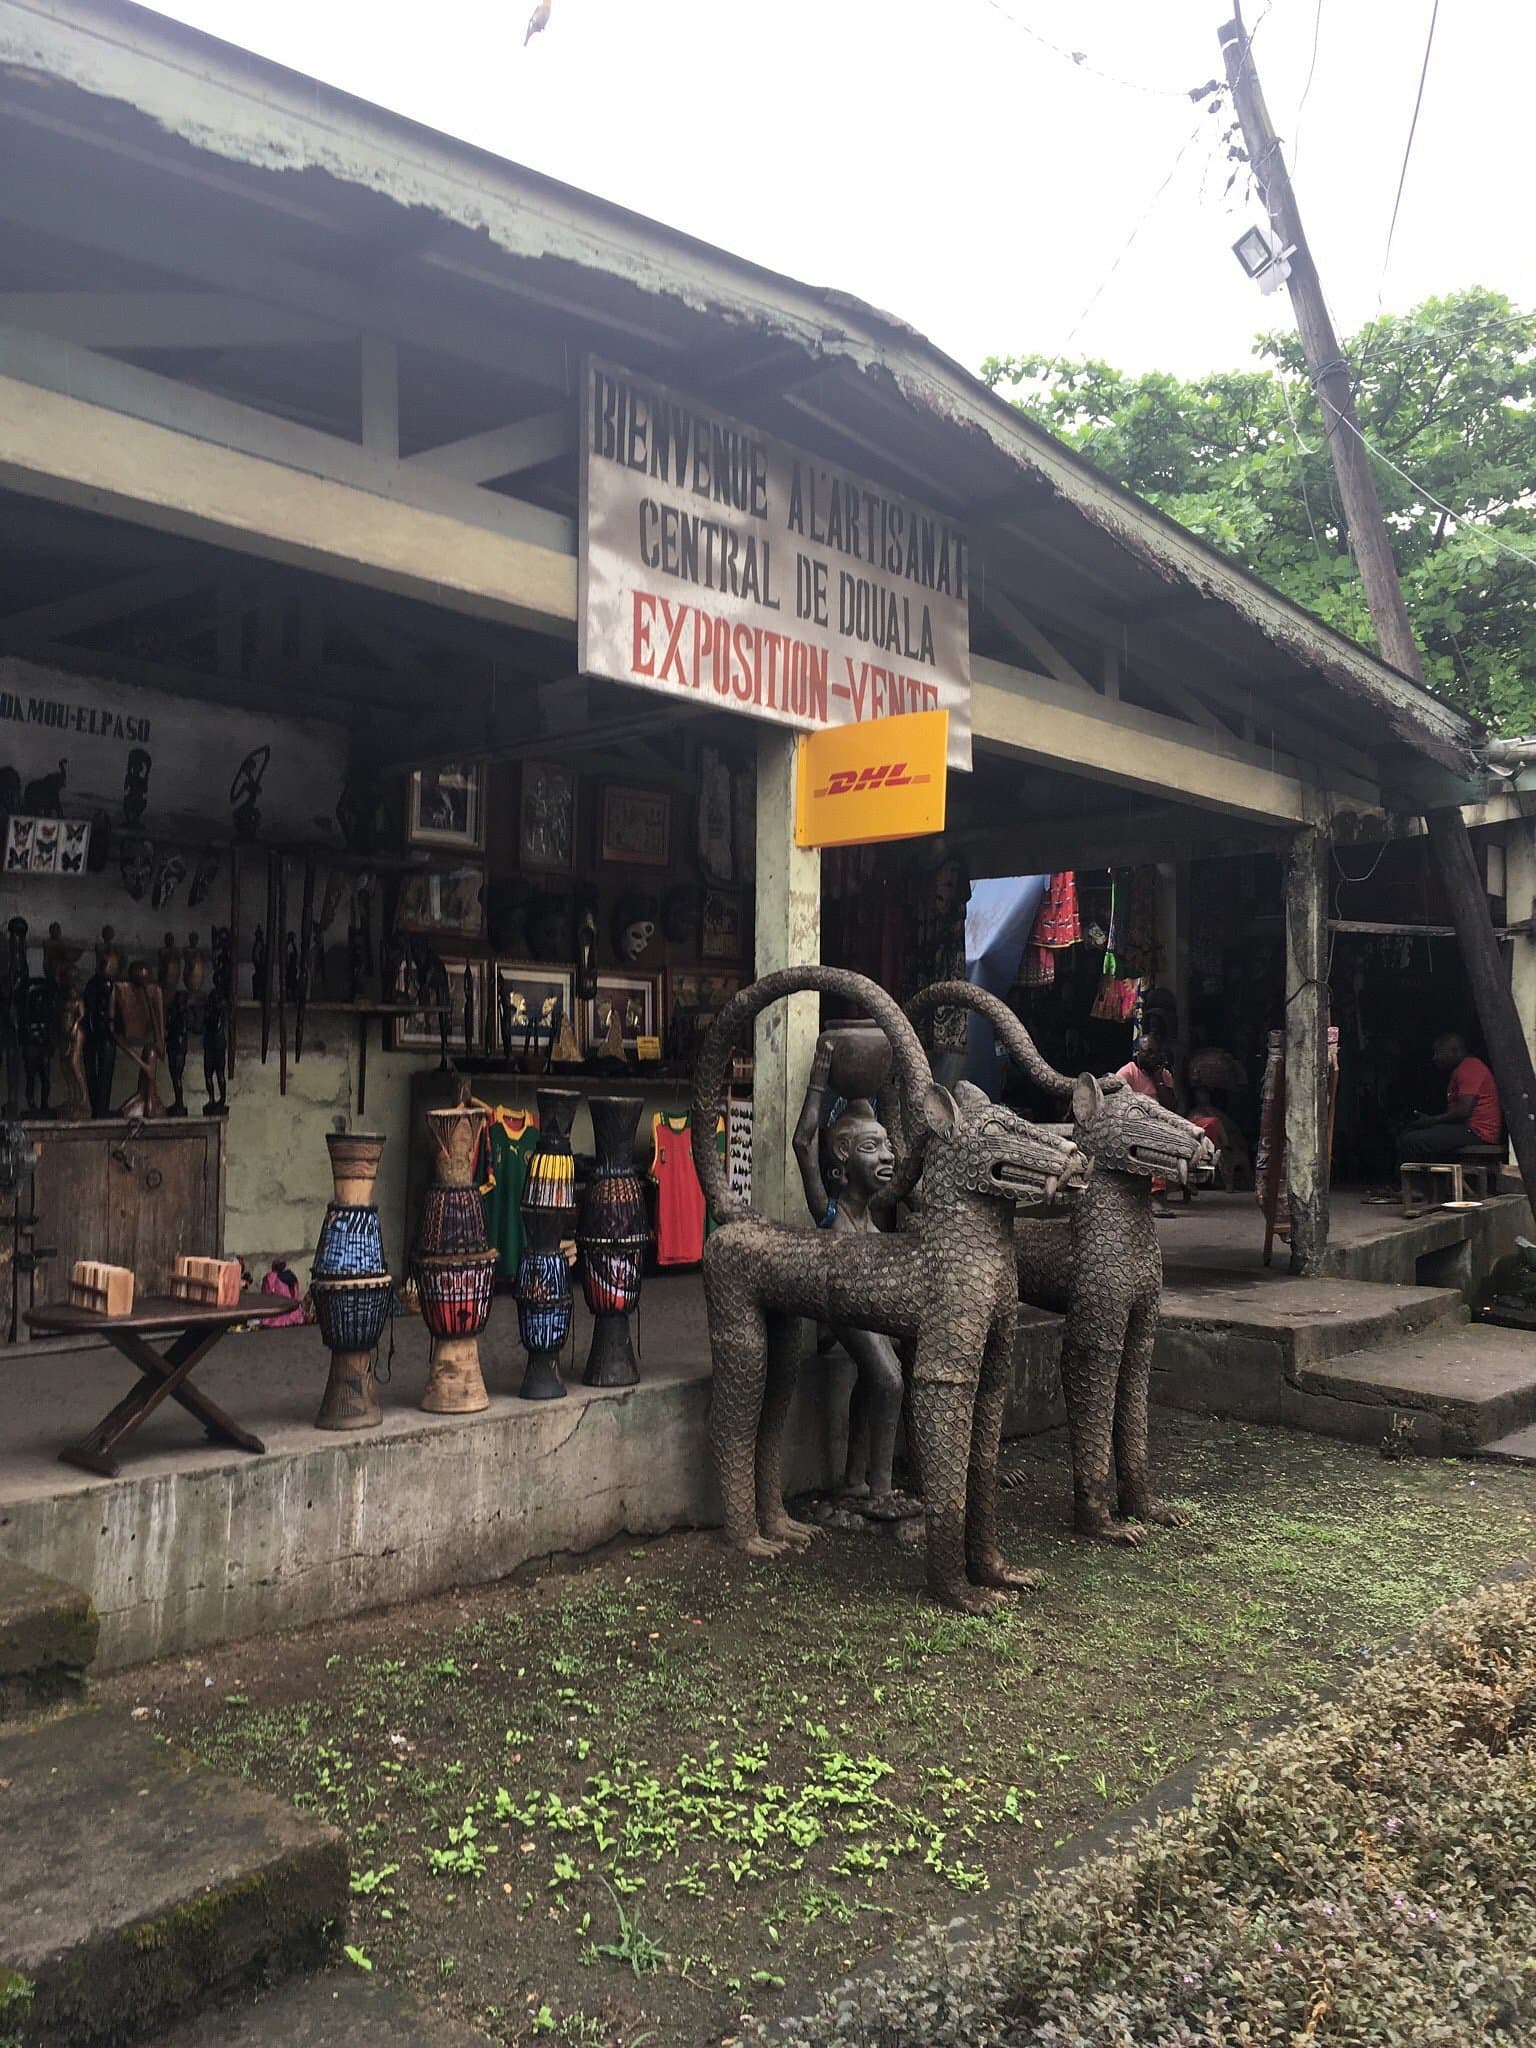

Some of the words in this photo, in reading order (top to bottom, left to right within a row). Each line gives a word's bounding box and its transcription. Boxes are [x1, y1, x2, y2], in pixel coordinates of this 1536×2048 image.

[594, 369, 768, 520] BIENVENUE
[639, 498, 780, 610] CENTRAL
[796, 552, 828, 628] DE
[839, 570, 936, 666] DOUALA
[828, 763, 913, 795] DHL
